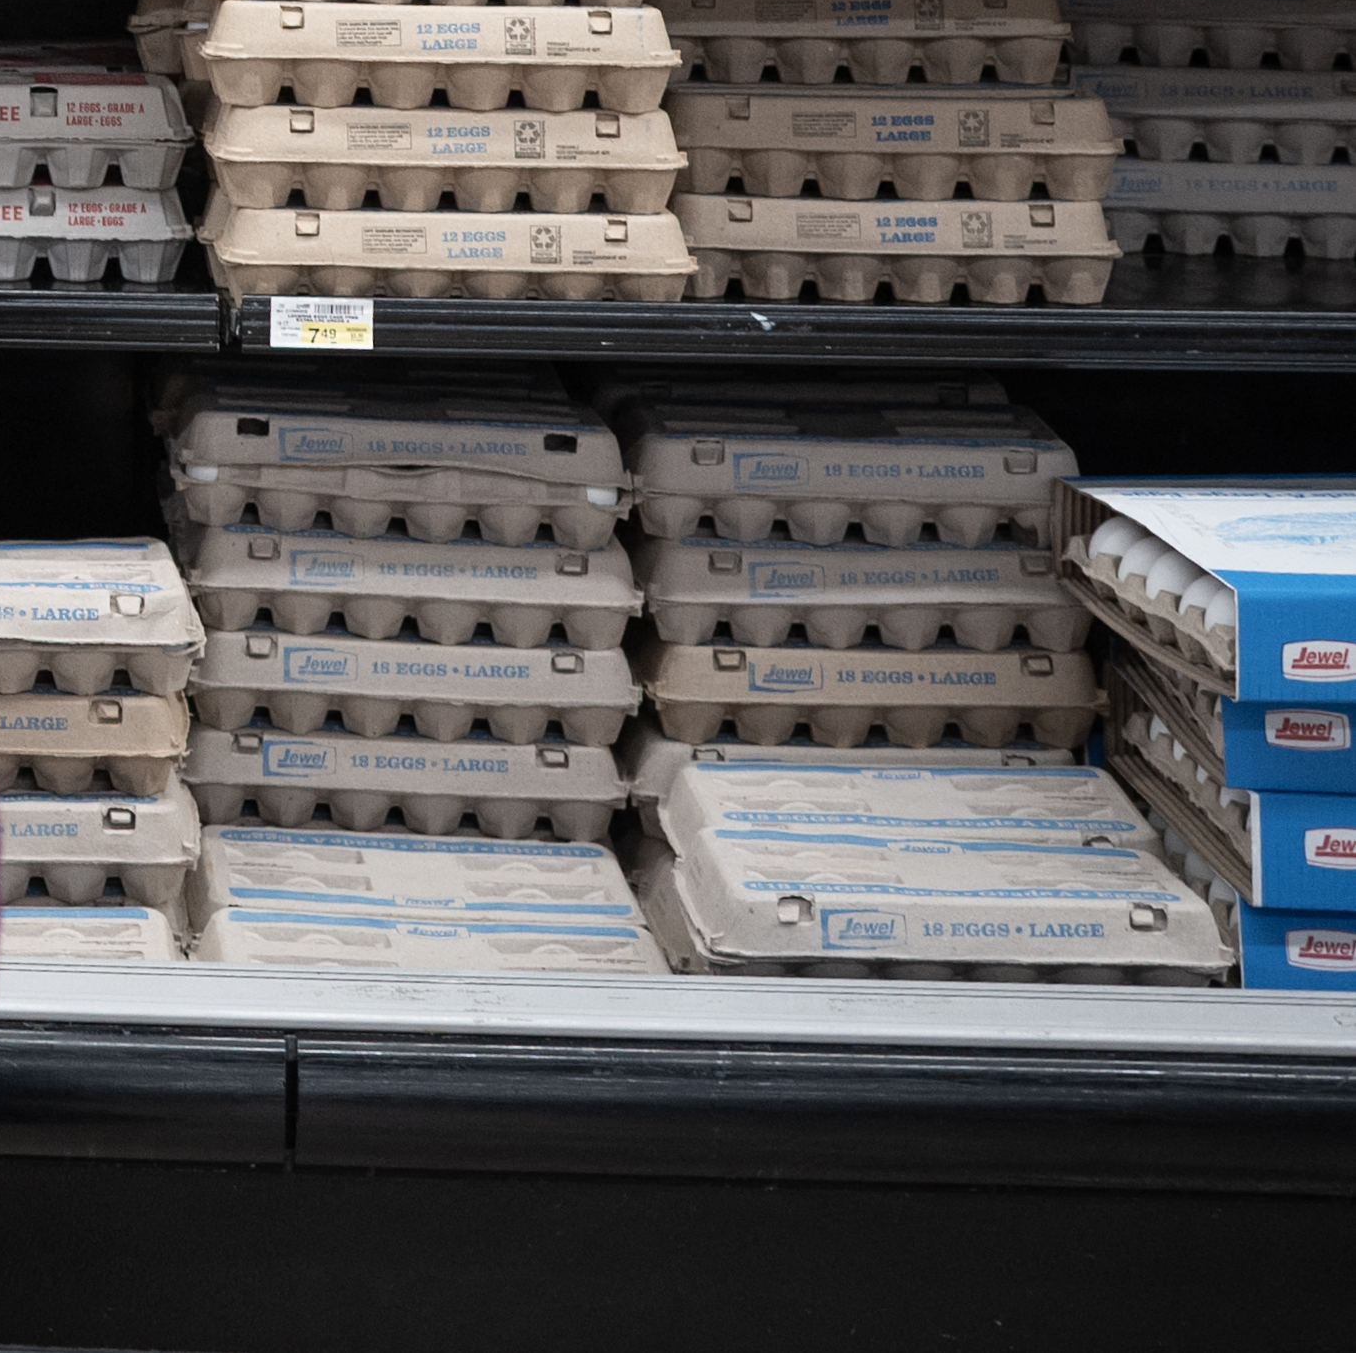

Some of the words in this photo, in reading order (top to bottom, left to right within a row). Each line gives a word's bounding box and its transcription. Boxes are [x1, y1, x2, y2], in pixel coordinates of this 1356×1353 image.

[65, 103, 76, 114] 12
[80, 102, 103, 114] EGGS
[108, 102, 136, 114] GRADE
[138, 102, 145, 114] A
[65, 114, 94, 127] LARGE
[98, 115, 123, 126] EGGS
[875, 217, 890, 228] 12
[894, 215, 937, 228] EGGS
[441, 231, 457, 244] 12
[462, 230, 507, 244] EGGS
[880, 230, 936, 242] LARGE
[446, 246, 503, 260] LARGE
[751, 459, 801, 479] Jewel
[824, 463, 842, 477] 18
[847, 463, 901, 478] EGGS
[917, 464, 985, 479] LARGE
[31, 606, 100, 621] LARGE
[1291, 647, 1349, 665] Jewel
[1276, 717, 1333, 737] Jewel
[277, 749, 328, 768] Jewel
[350, 756, 368, 770] 18
[373, 755, 426, 770] EGGS
[441, 758, 509, 773] LARGE
[839, 918, 896, 940] Jewel
[922, 922, 944, 938] 18
[949, 922, 1009, 938] EGGS
[1028, 922, 1104, 939] LARGE
